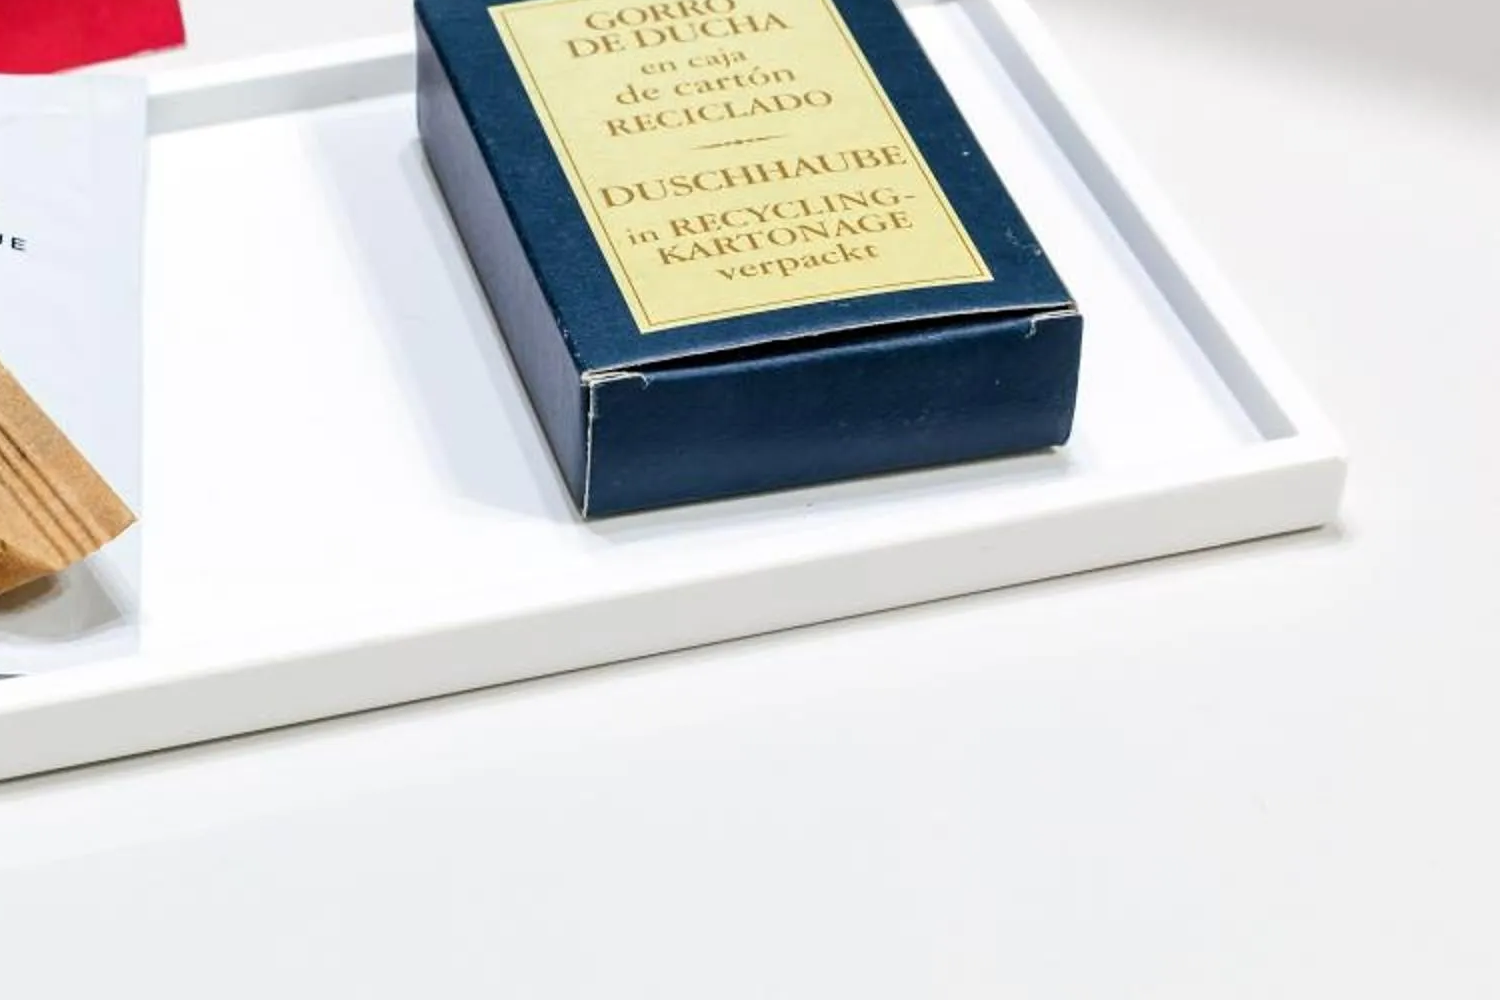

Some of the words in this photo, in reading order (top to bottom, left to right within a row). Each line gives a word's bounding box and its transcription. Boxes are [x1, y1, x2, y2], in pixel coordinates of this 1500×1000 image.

[565, 35, 626, 58] DE
[634, 12, 794, 49] DUCHA
[640, 60, 678, 76] en
[688, 48, 748, 68] caja
[615, 83, 660, 105] de
[673, 65, 796, 97] cartón
[606, 89, 833, 137] RECICLADO
[599, 144, 908, 208] DUSCHHAUBE
[626, 227, 659, 245] in
[656, 210, 914, 265] KARTONAGE
[717, 243, 880, 281] verpackt
